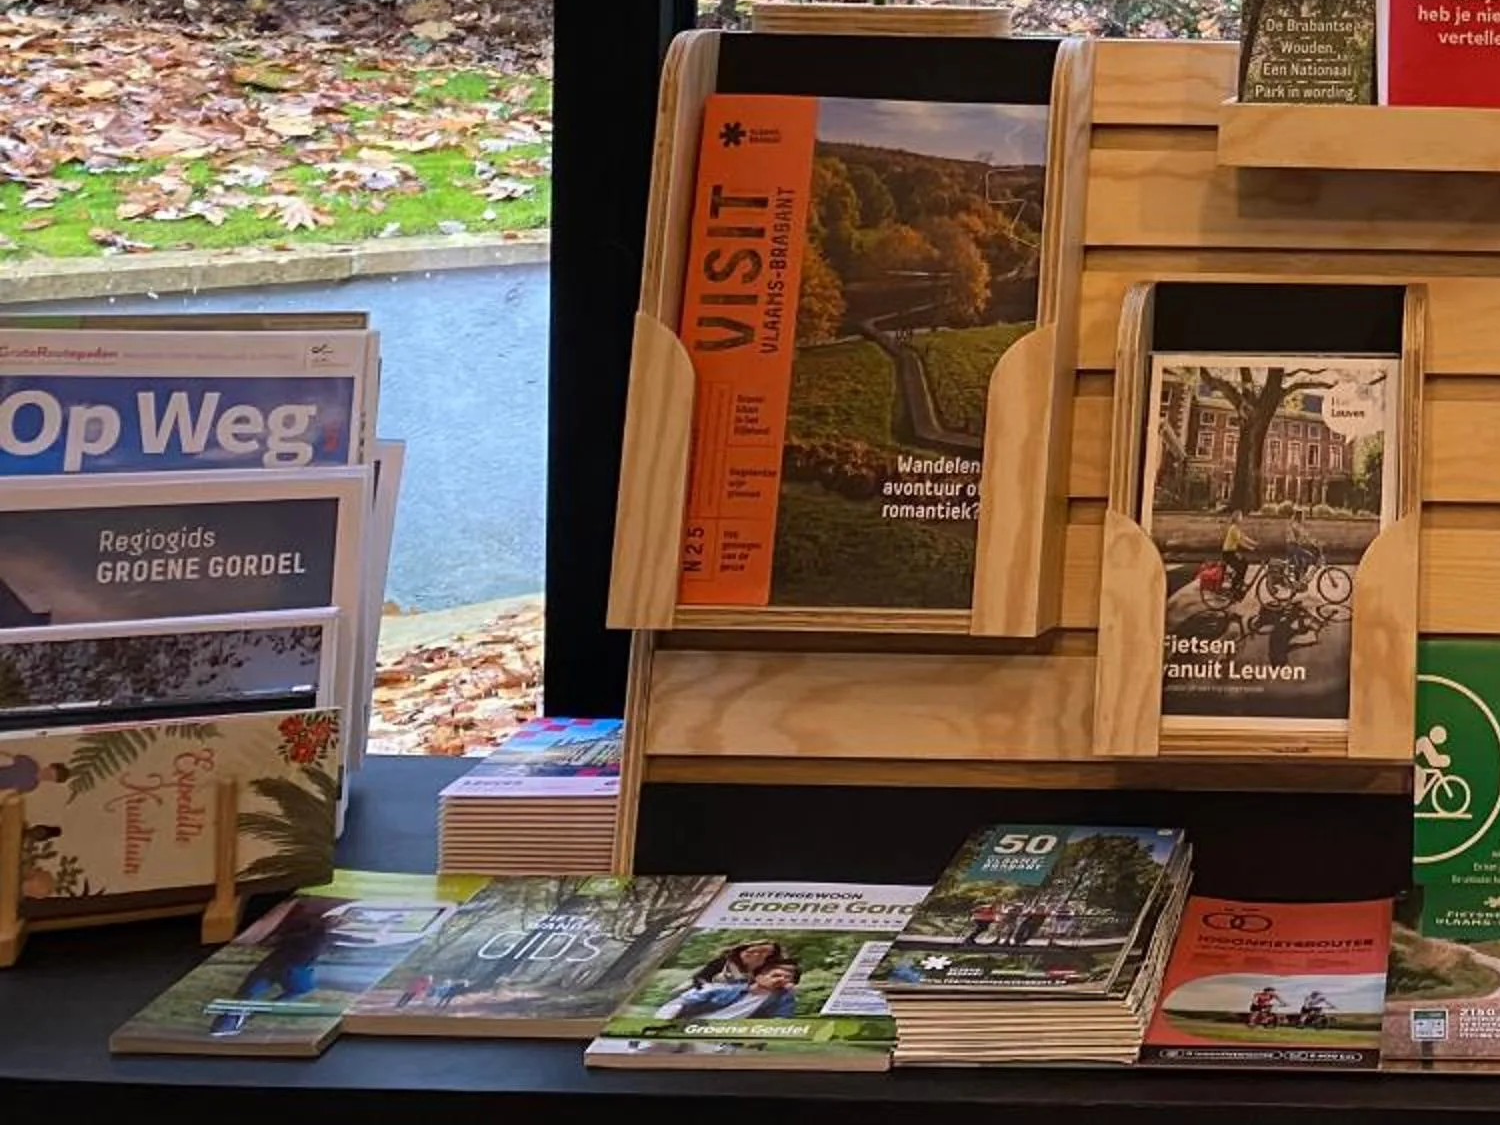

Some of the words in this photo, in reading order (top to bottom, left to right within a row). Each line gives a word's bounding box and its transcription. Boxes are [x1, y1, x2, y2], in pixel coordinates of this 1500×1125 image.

[1418, 5, 1449, 22] heb
[1455, 6, 1471, 25] je
[1266, 19, 1284, 32] De
[1287, 19, 1353, 32] Brabantse
[1263, 62, 1287, 76] Een
[1290, 61, 1352, 76] Nationaal
[1255, 84, 1285, 98] Park
[1288, 85, 1299, 98] in
[694, 184, 769, 352] VISIT
[759, 187, 796, 353] VLAAMS-BRABANT
[0, 389, 121, 472] Op
[136, 391, 317, 467] Weg
[898, 455, 981, 474] Wandelen
[883, 479, 962, 496] avontuur
[967, 483, 980, 497] o
[100, 527, 216, 557] Regiogids
[97, 557, 200, 584] GROENE
[208, 551, 306, 579] GORDEL
[1229, 661, 1306, 681] Leuven
[994, 834, 1058, 854] 50
[728, 900, 839, 914] Groene
[478, 931, 613, 962] GIDS
[684, 1025, 746, 1036] Groene
[751, 1025, 810, 1036] Gordel
